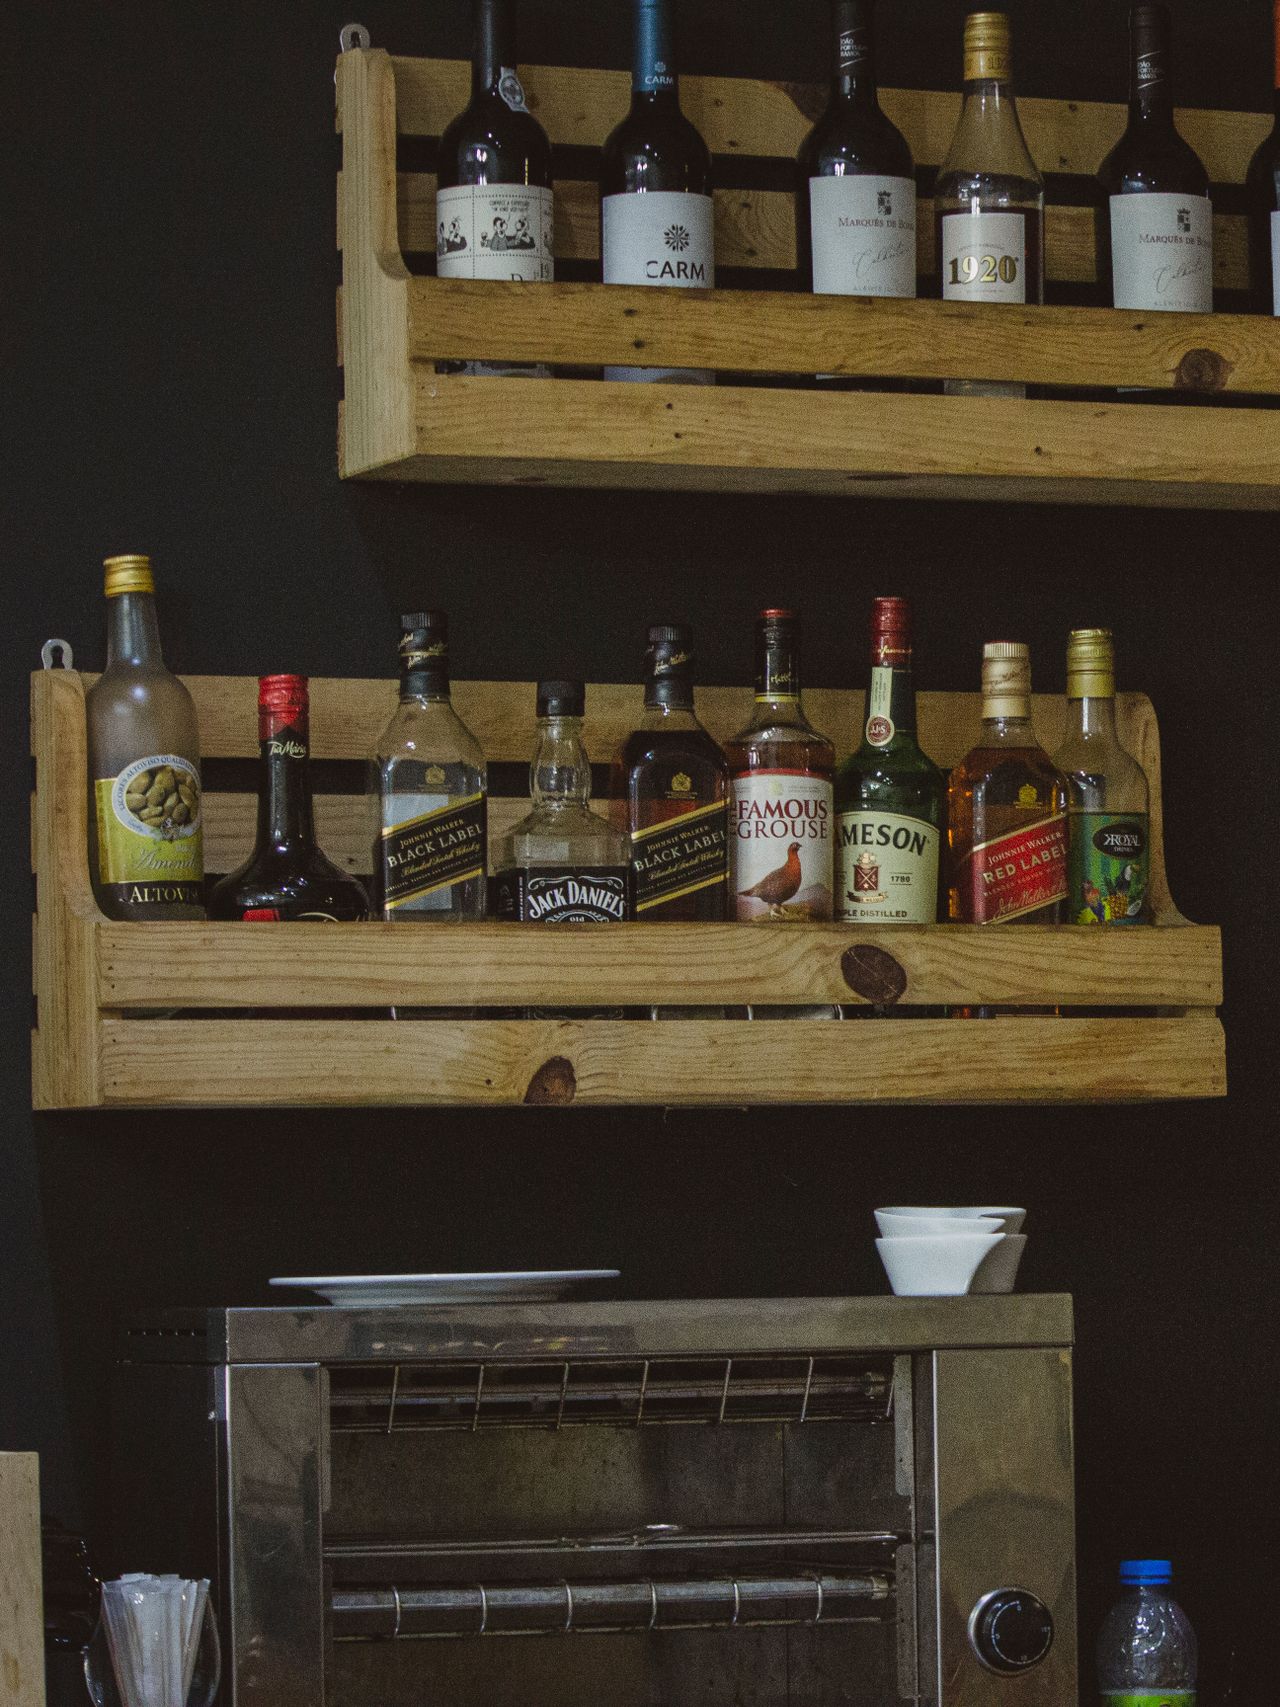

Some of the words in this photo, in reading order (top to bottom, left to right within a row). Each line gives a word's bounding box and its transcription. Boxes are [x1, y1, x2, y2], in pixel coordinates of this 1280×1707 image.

[645, 76, 674, 84] CARM
[645, 260, 706, 281] CARM
[949, 255, 1017, 285] 1920
[738, 799, 828, 820] FAMOUS
[737, 820, 828, 839] GROUSE
[840, 822, 927, 856] MESON
[387, 841, 436, 868] BLACK
[439, 822, 484, 848] LABEL
[634, 846, 682, 871] BLACK
[987, 846, 1026, 866] JOHNNIE
[1026, 831, 1063, 849] WALKER
[983, 862, 1017, 884] RED
[1020, 843, 1067, 872] LABEL
[527, 887, 567, 920] JACK
[567, 880, 624, 919] DANIEL'S
[860, 910, 908, 918] DISTILLED
